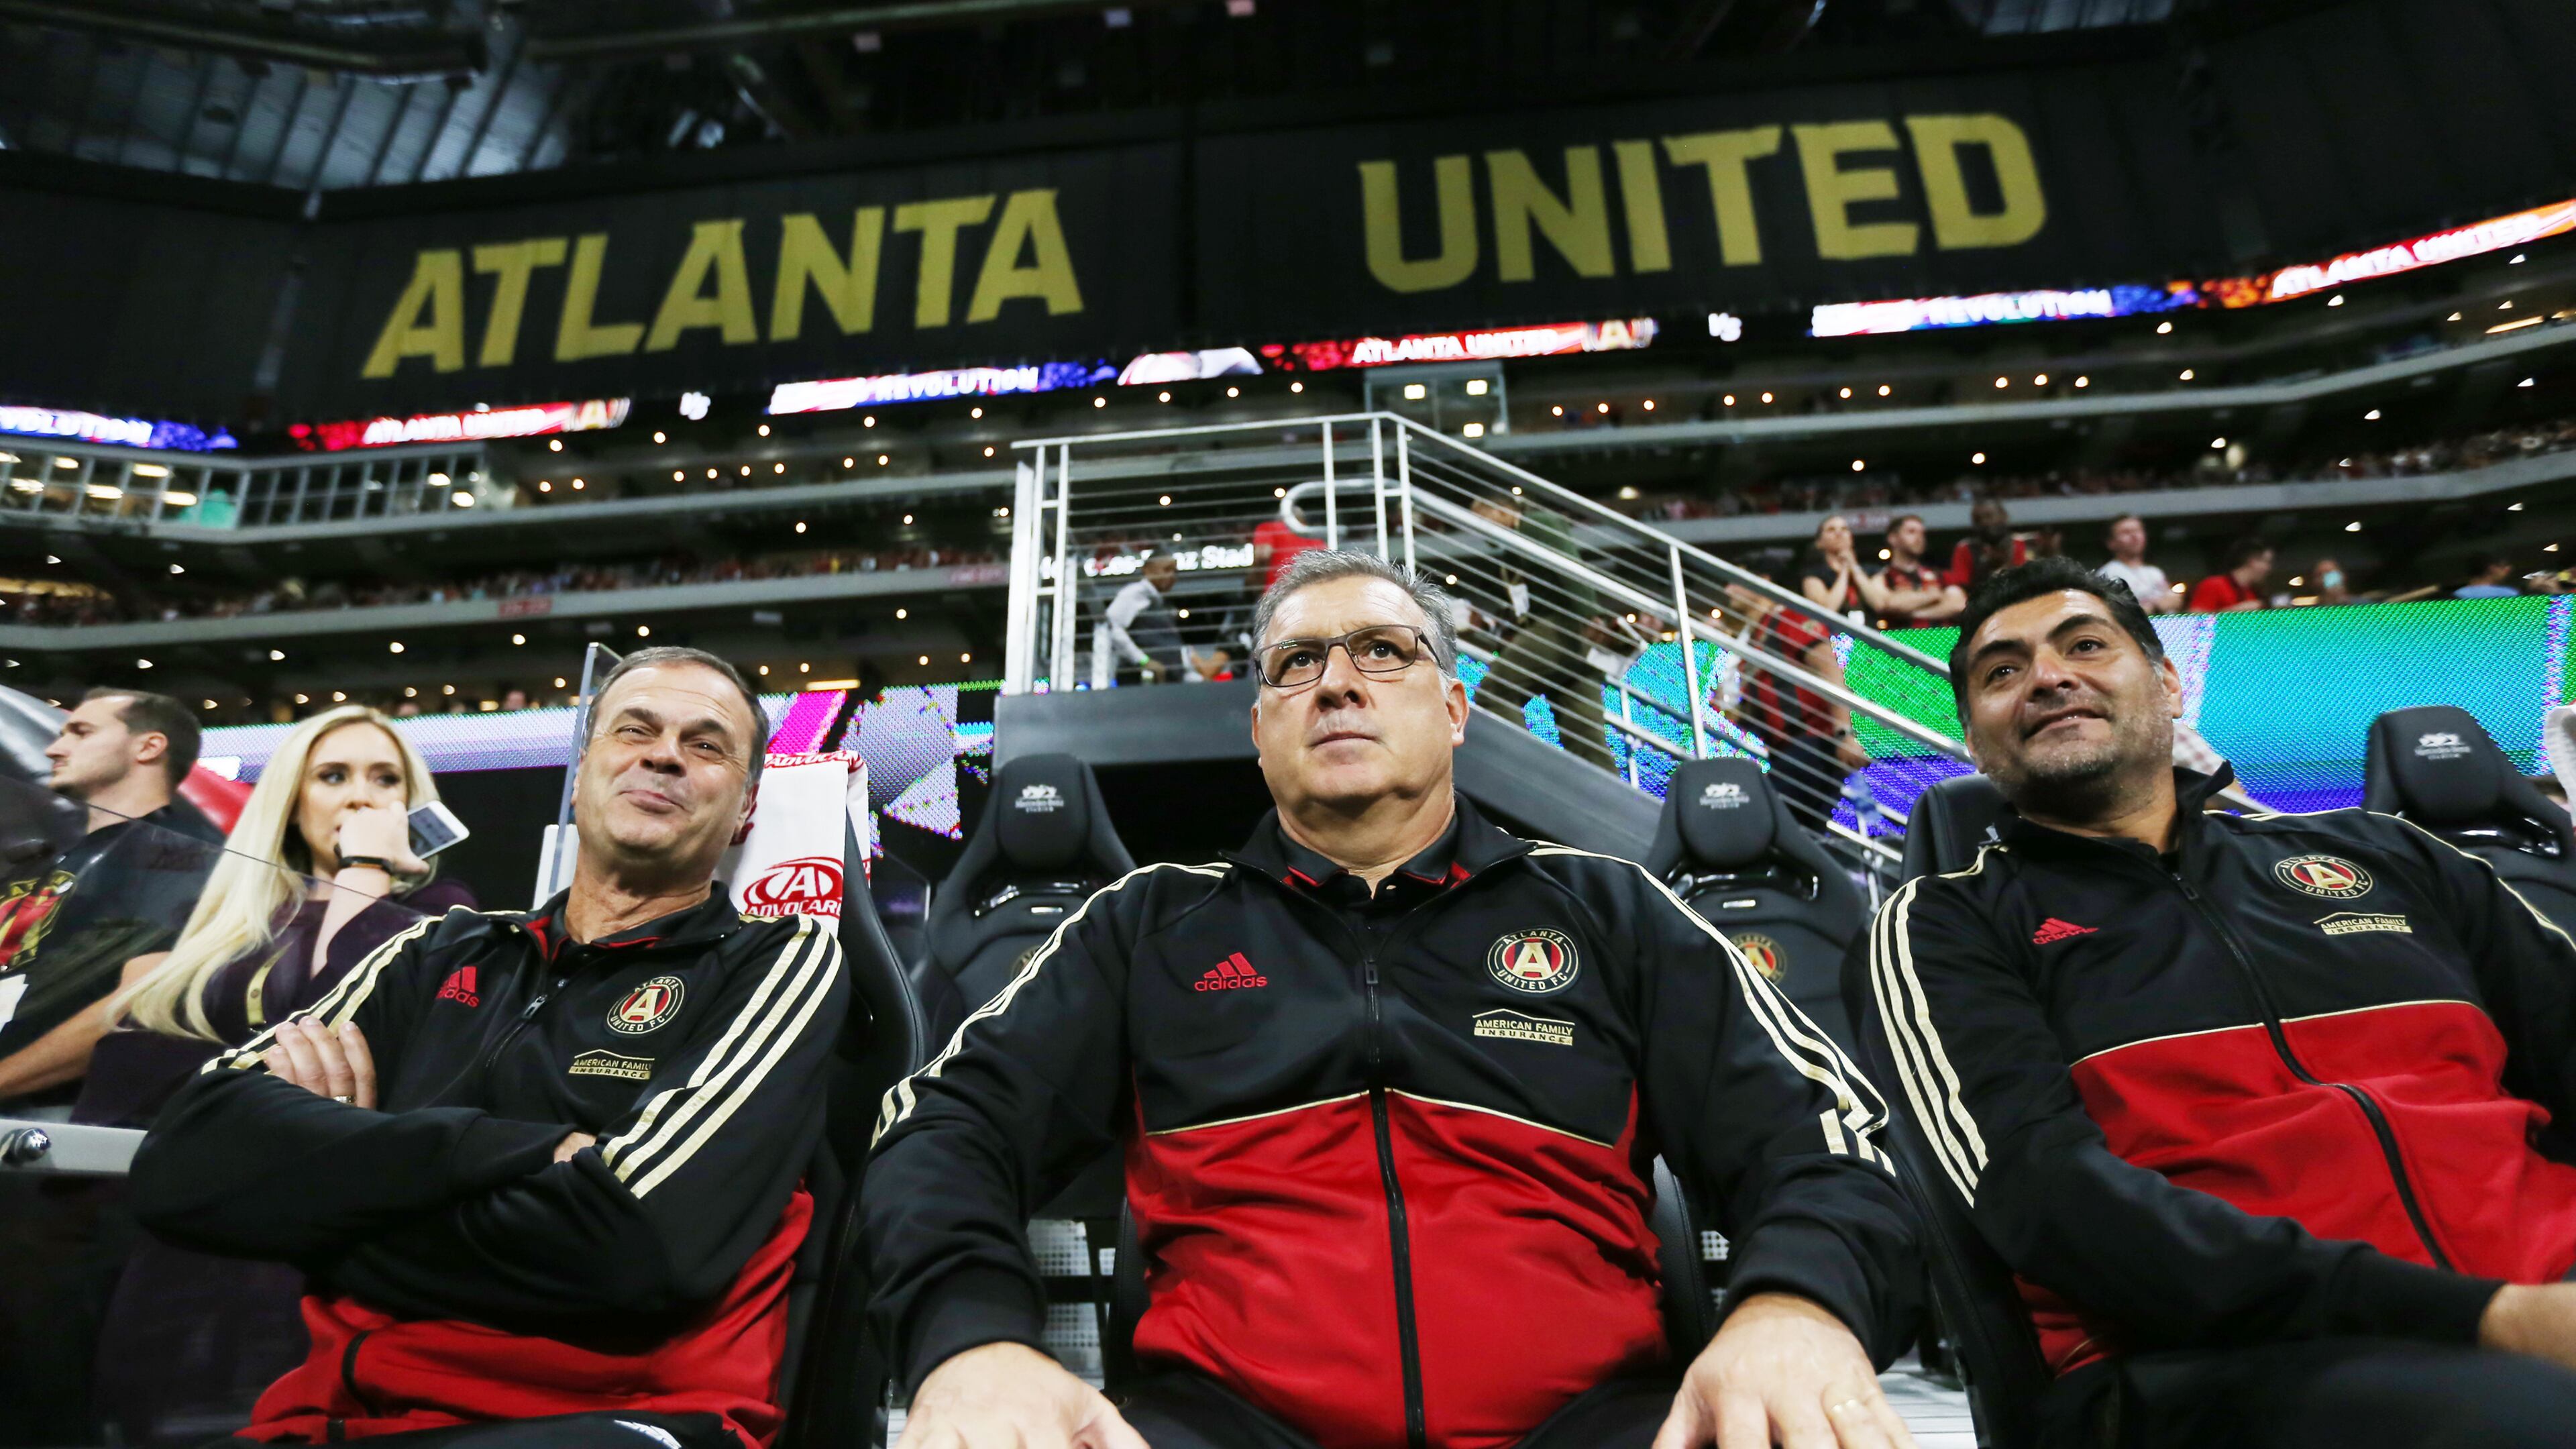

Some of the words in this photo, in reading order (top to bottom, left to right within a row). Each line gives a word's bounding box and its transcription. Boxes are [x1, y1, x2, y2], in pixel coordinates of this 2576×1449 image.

[363, 189, 1084, 378] ATLANTA
[1358, 113, 2046, 294] UNITED
[2272, 244, 2415, 298] ATLANTA
[1927, 289, 2112, 325] REVOLUTION
[1352, 335, 1464, 364] ATLANTA
[1465, 329, 1558, 358] UNITED
[875, 366, 1039, 402] REVOLUTION
[363, 414, 462, 445] ATLANTA
[2305, 886, 2357, 897] UNITED
[2355, 879, 2369, 891] FC
[2320, 917, 2373, 930] AMERICAN
[2373, 916, 2406, 926] FAMILY
[2331, 924, 2406, 934] INSURANCE
[1503, 930, 1564, 945] ATLANTA
[1194, 975, 1268, 991] adidas
[1497, 969, 1546, 990] UNITED
[1550, 972, 1568, 986] FC
[610, 1015, 644, 1032] UNITED
[649, 1015, 665, 1028] FC
[1475, 1019, 1532, 1031] AMERICAN
[1535, 1022, 1573, 1036] FAMILY
[1481, 1028, 1566, 1043] INSURANCE
[574, 1058, 619, 1068] AMERICAN
[575, 1067, 646, 1079] INSURANCE
